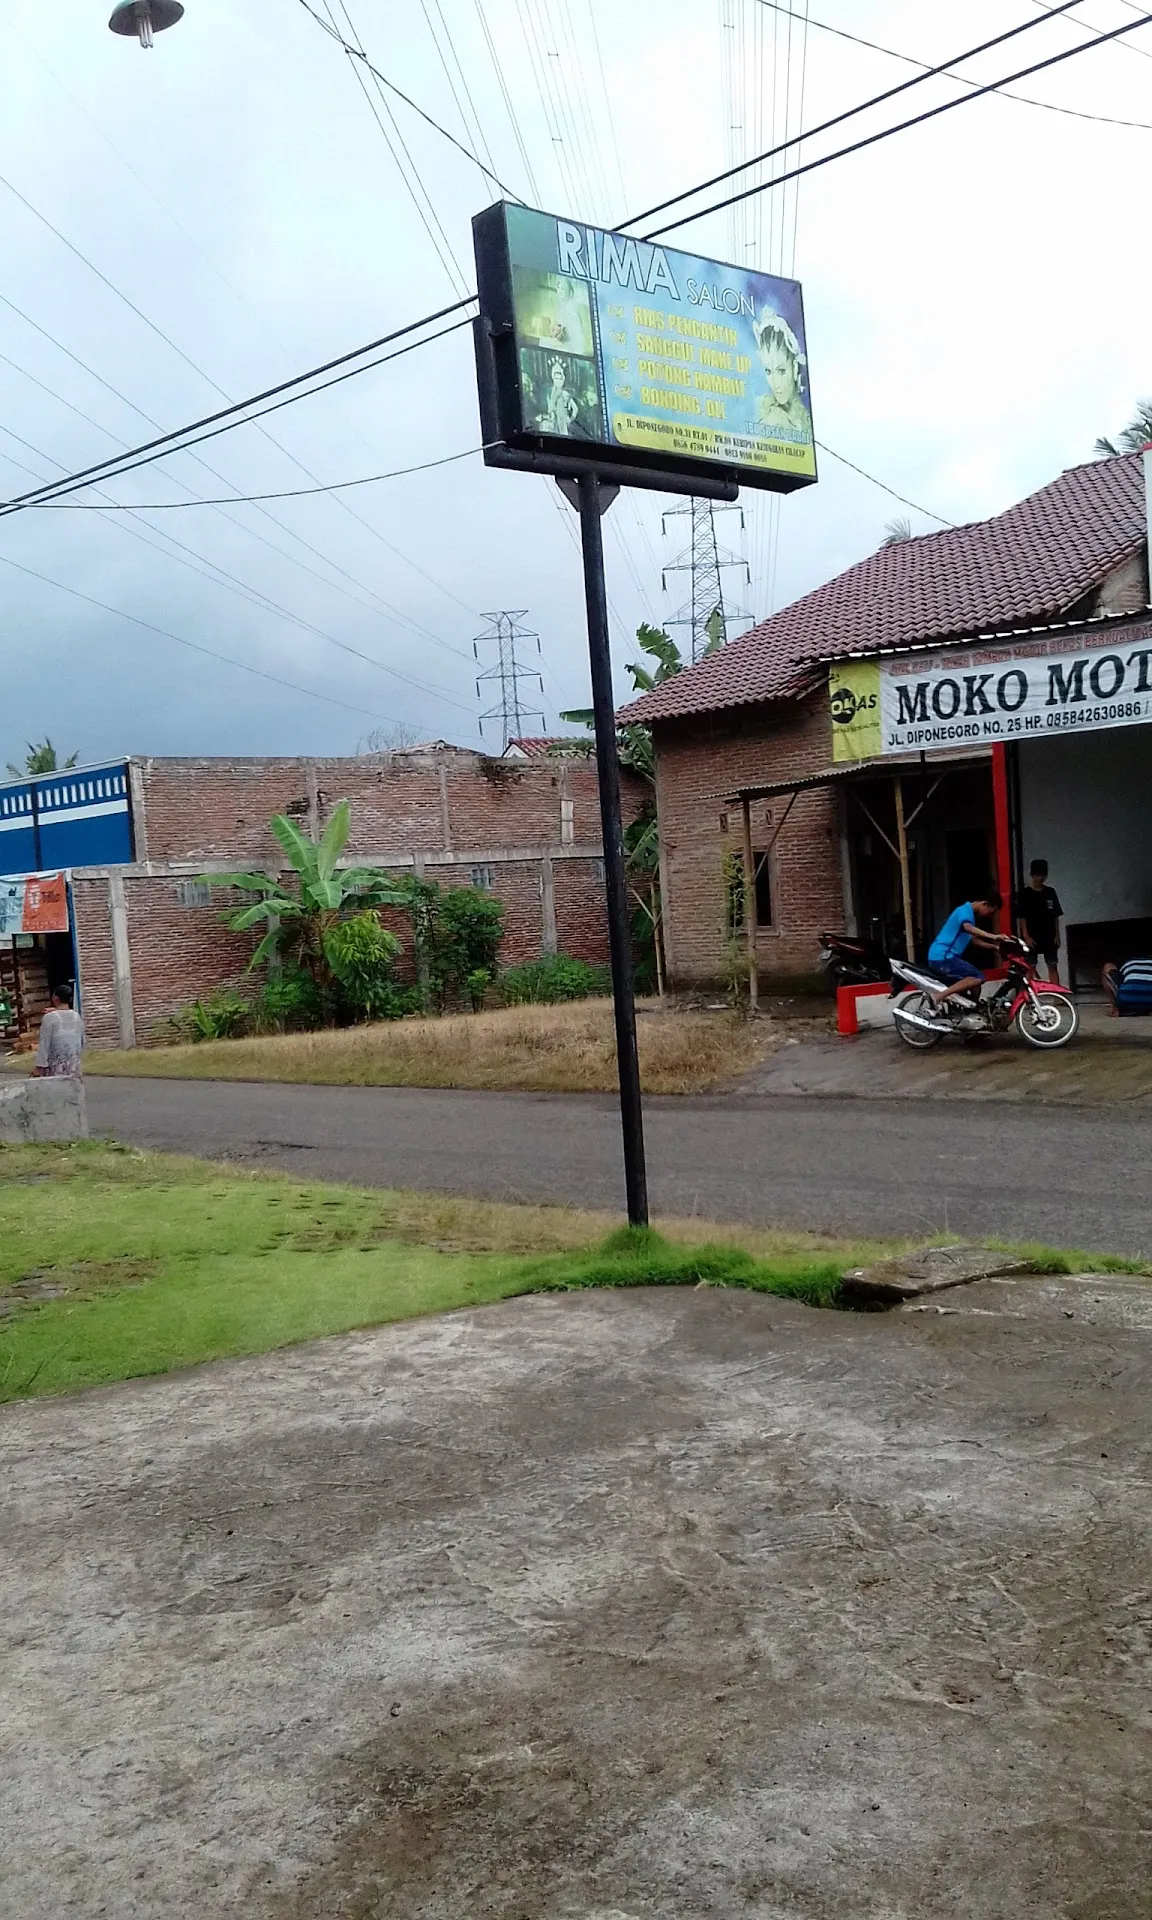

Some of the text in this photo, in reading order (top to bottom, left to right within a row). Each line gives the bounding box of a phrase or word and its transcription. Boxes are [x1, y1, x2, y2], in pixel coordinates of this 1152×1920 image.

[557, 220, 681, 301] RIMA
[686, 278, 757, 318] SALON
[668, 314, 738, 347] PENGANTIN
[638, 359, 745, 397] POTONG RAMBUT
[700, 347, 734, 371] MAKE
[737, 354, 752, 374] UP
[1050, 635, 1083, 654] BEKAS
[1084, 624, 1152, 648] BERKUALITA
[895, 669, 1029, 725] MOKO
[888, 733, 904, 746] JL.
[907, 723, 980, 744] DIPONEGORO
[983, 720, 1004, 736] NO.
[1007, 717, 1022, 732] 25
[1025, 716, 1043, 731] HP.
[1046, 701, 1141, 727] 085842630886
